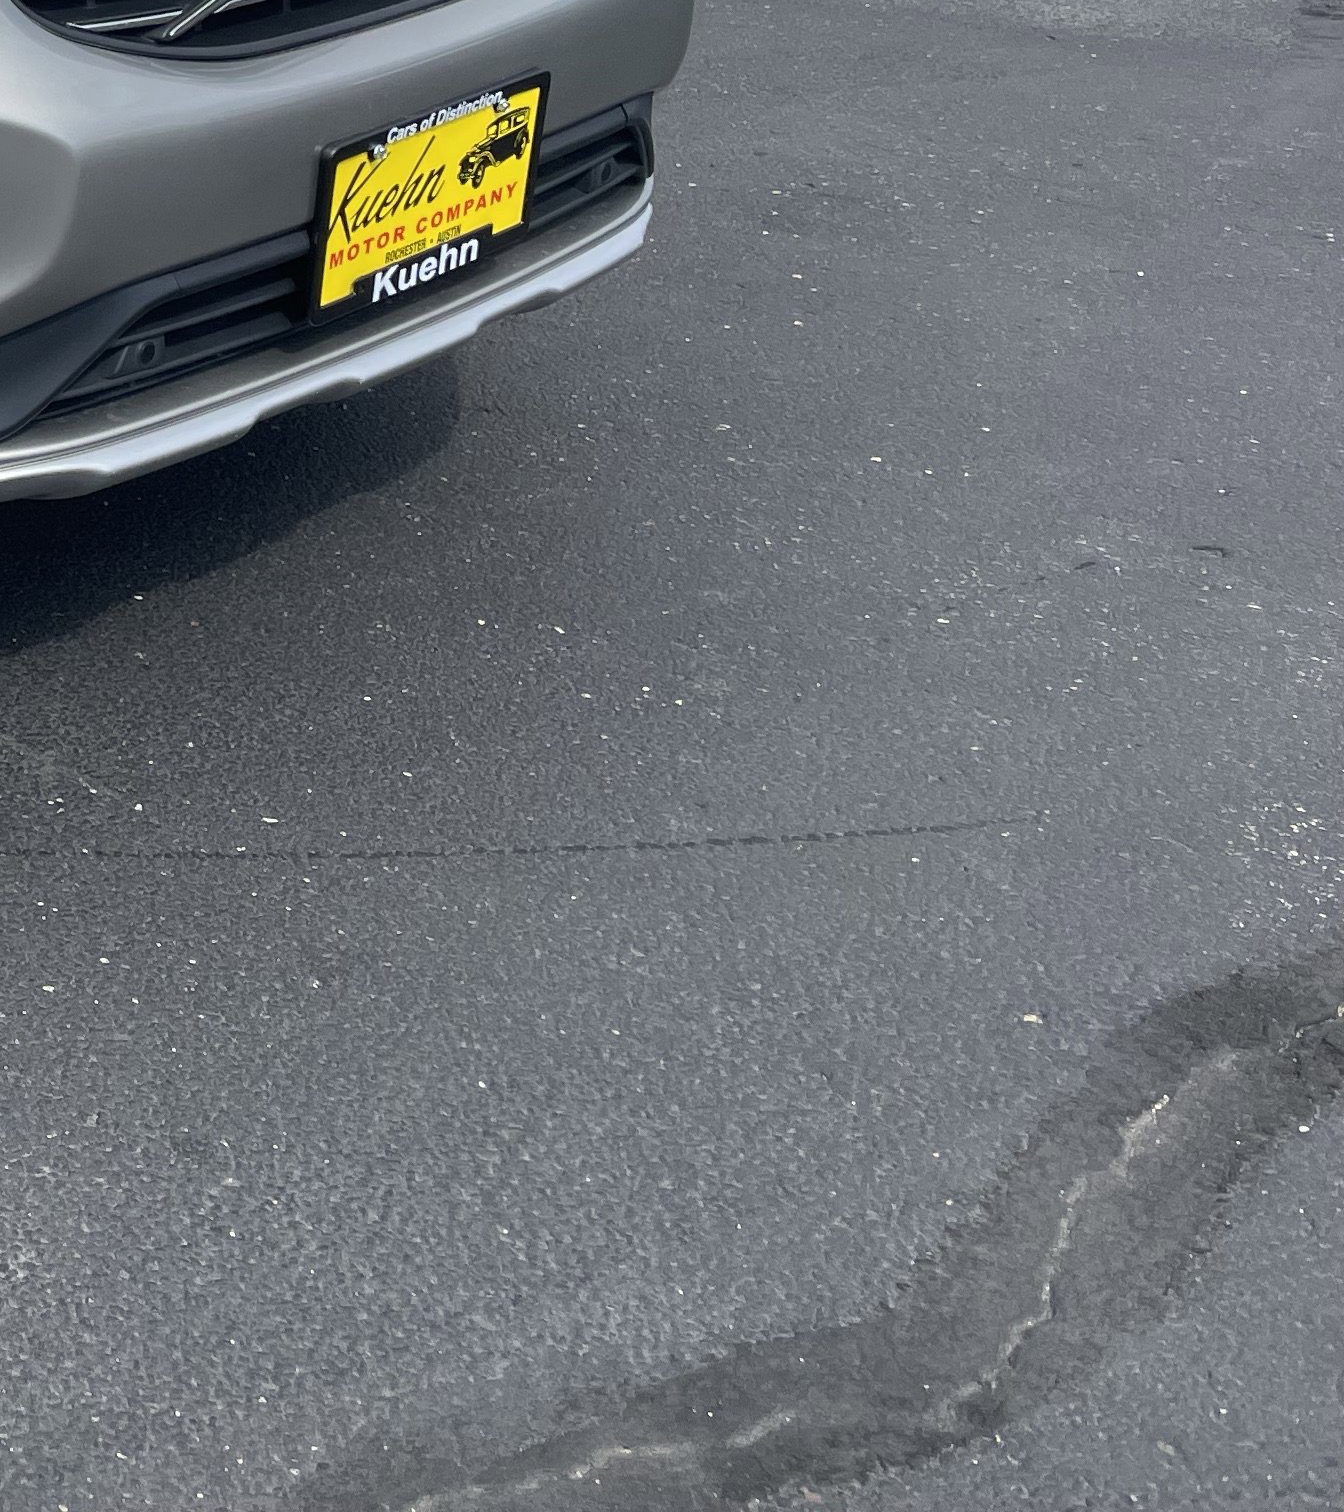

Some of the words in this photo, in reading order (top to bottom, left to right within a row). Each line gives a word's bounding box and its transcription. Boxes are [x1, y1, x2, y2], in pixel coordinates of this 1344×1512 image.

[386, 121, 418, 144] Cars
[419, 113, 437, 133] of
[436, 90, 504, 126] Distinction
[328, 135, 447, 244] Kuehn
[329, 225, 405, 270] MOTOR
[415, 181, 518, 234] COMPANY
[385, 237, 427, 264] ROCHESTER
[436, 224, 462, 246] AUSTIN
[371, 238, 480, 303] Kuehn
